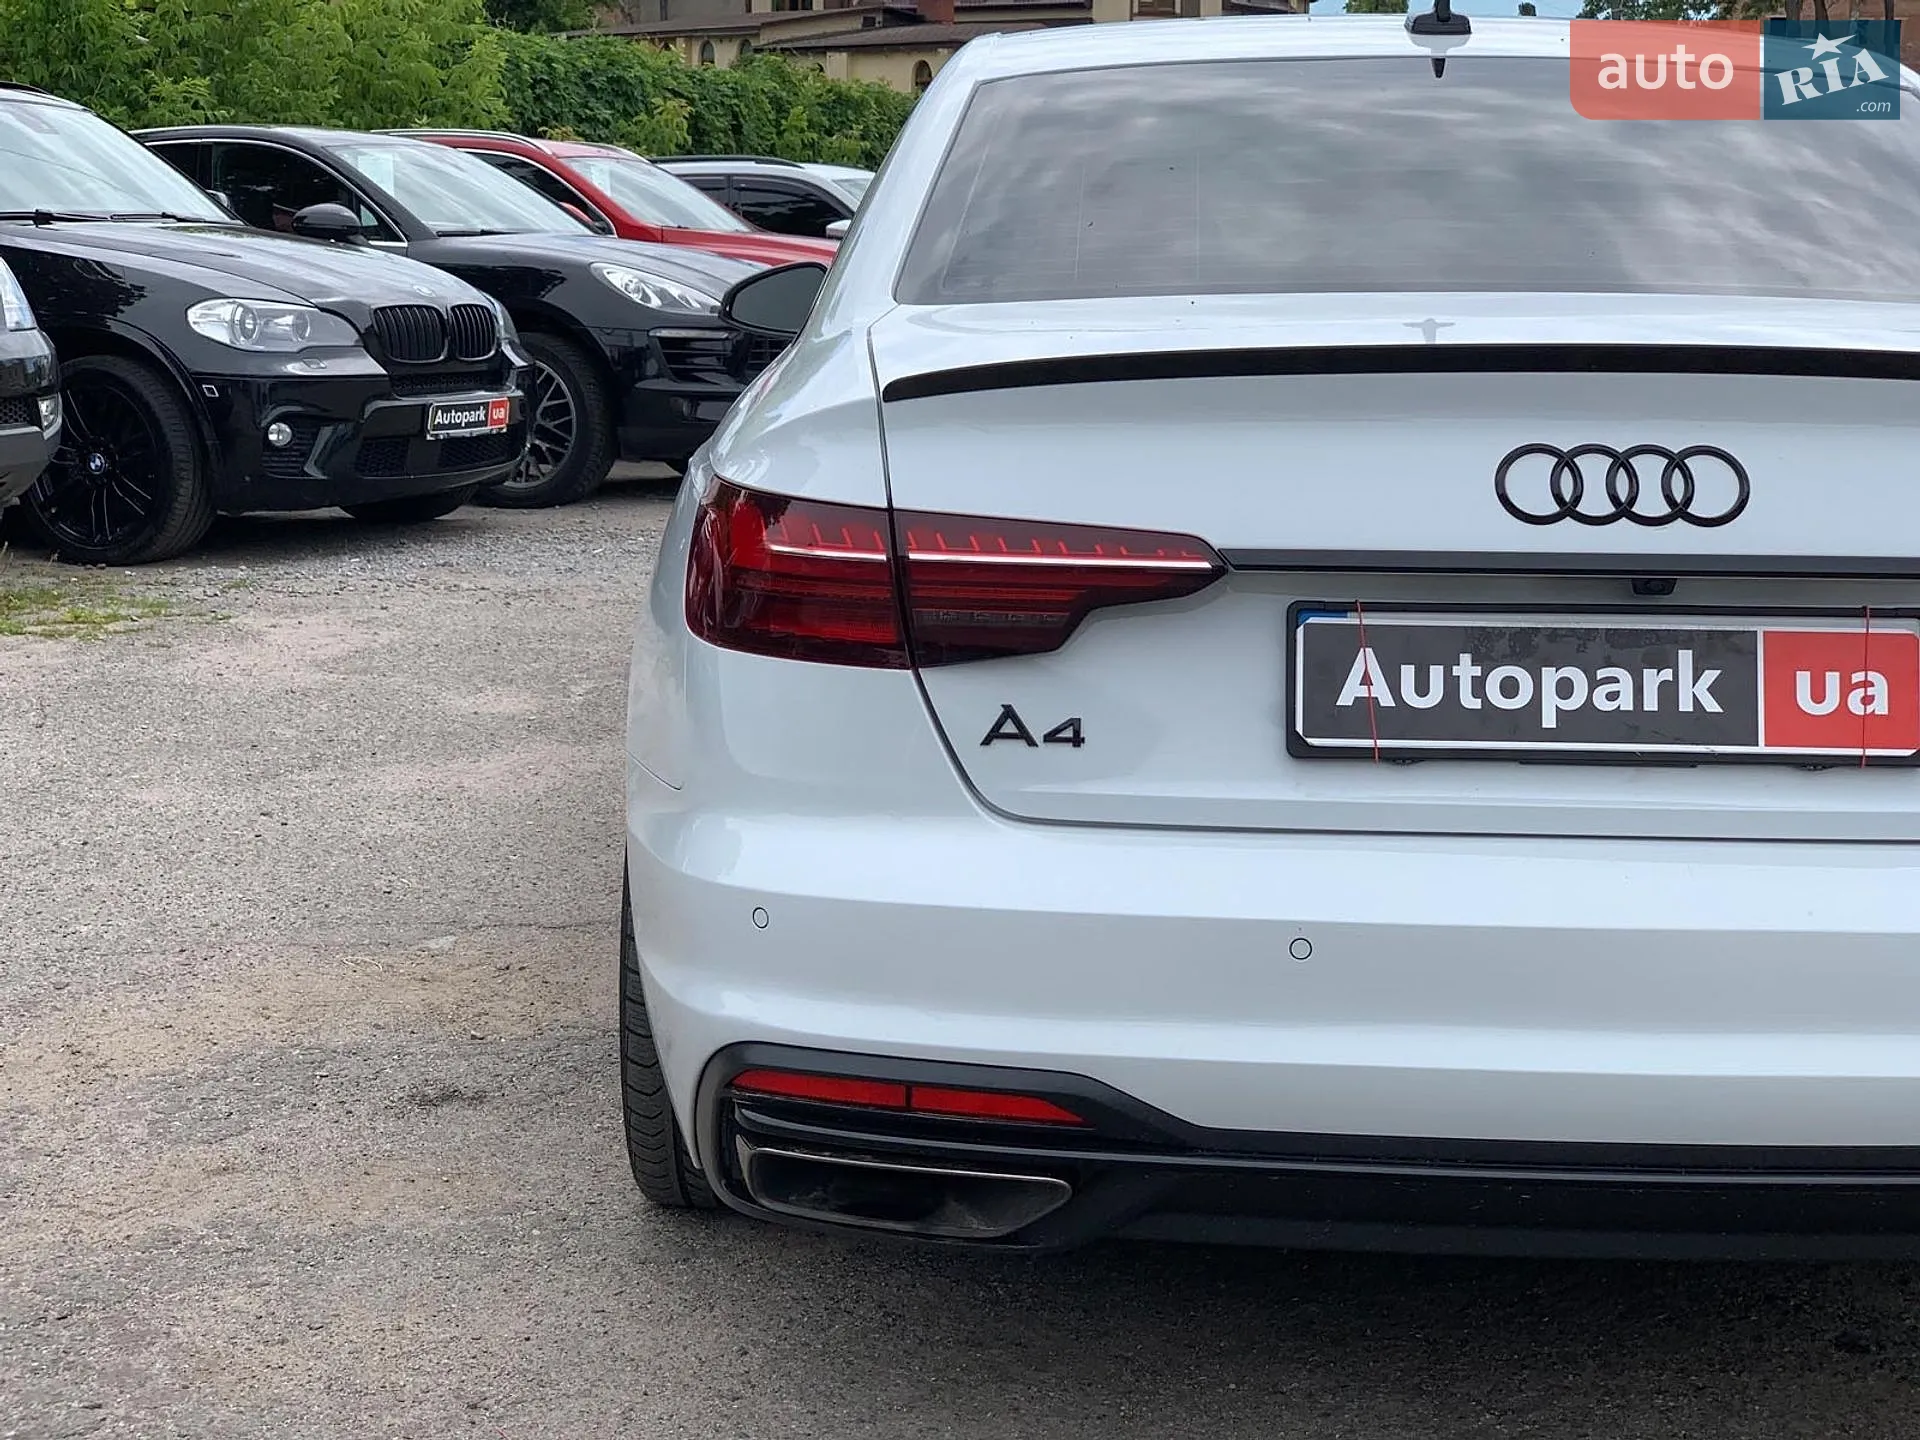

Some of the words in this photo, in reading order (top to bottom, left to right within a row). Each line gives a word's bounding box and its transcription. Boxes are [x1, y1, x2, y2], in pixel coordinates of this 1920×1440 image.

[434, 405, 486, 427] Autopark
[492, 407, 506, 420] ua
[1335, 647, 1724, 729] Autopark
[1796, 670, 1889, 716] ua
[979, 703, 1086, 748] A4
